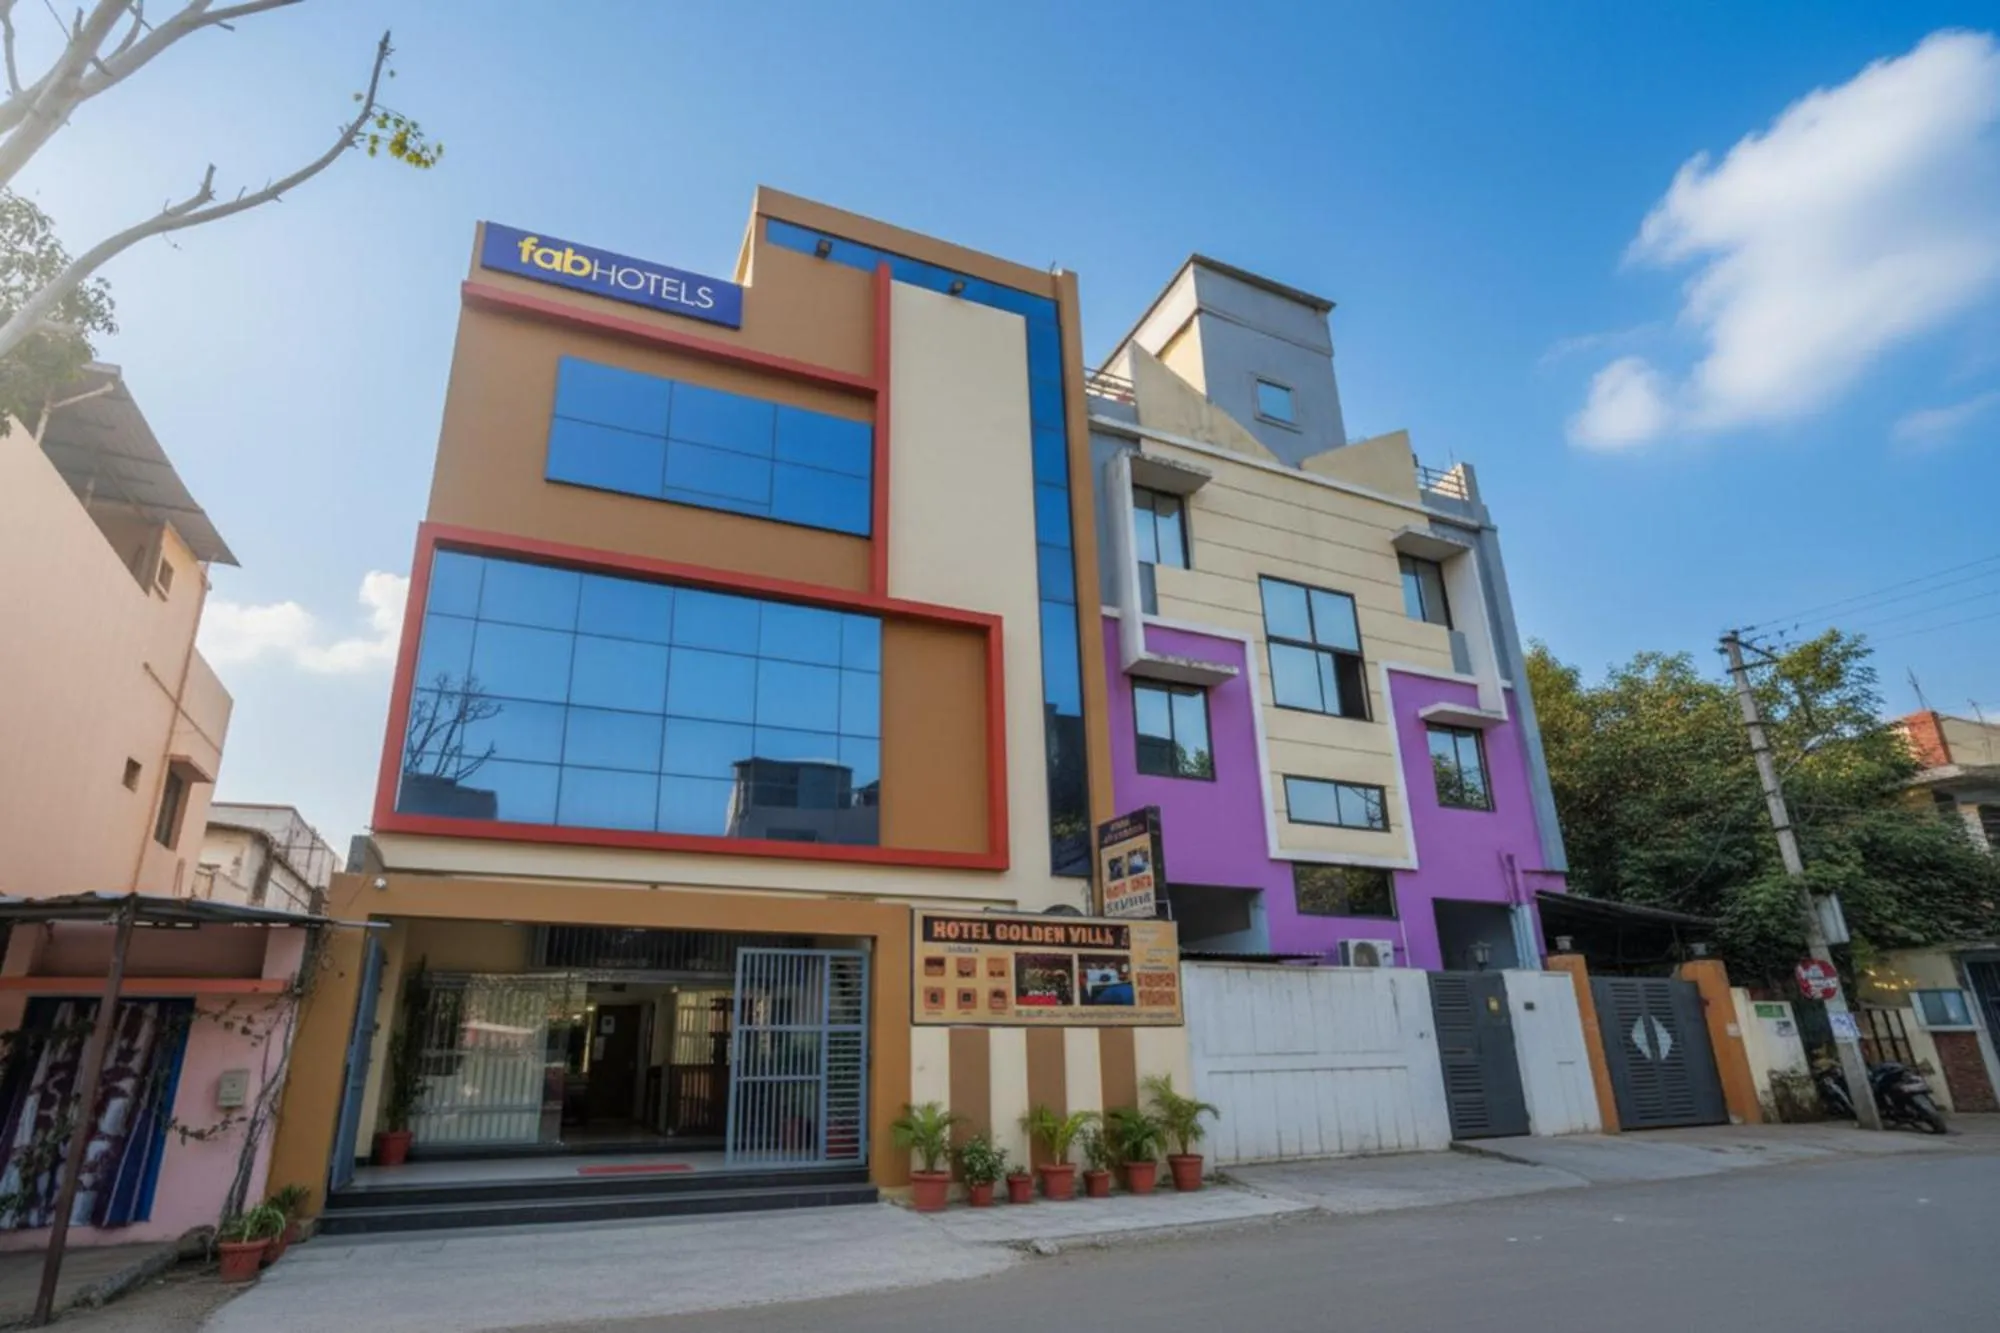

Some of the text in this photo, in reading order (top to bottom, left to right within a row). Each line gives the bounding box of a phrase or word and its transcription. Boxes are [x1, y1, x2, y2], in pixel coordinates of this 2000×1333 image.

[518, 237, 714, 308] fabHOTELS
[933, 921, 991, 940] HOTEL
[995, 924, 1065, 943] GOLDEN
